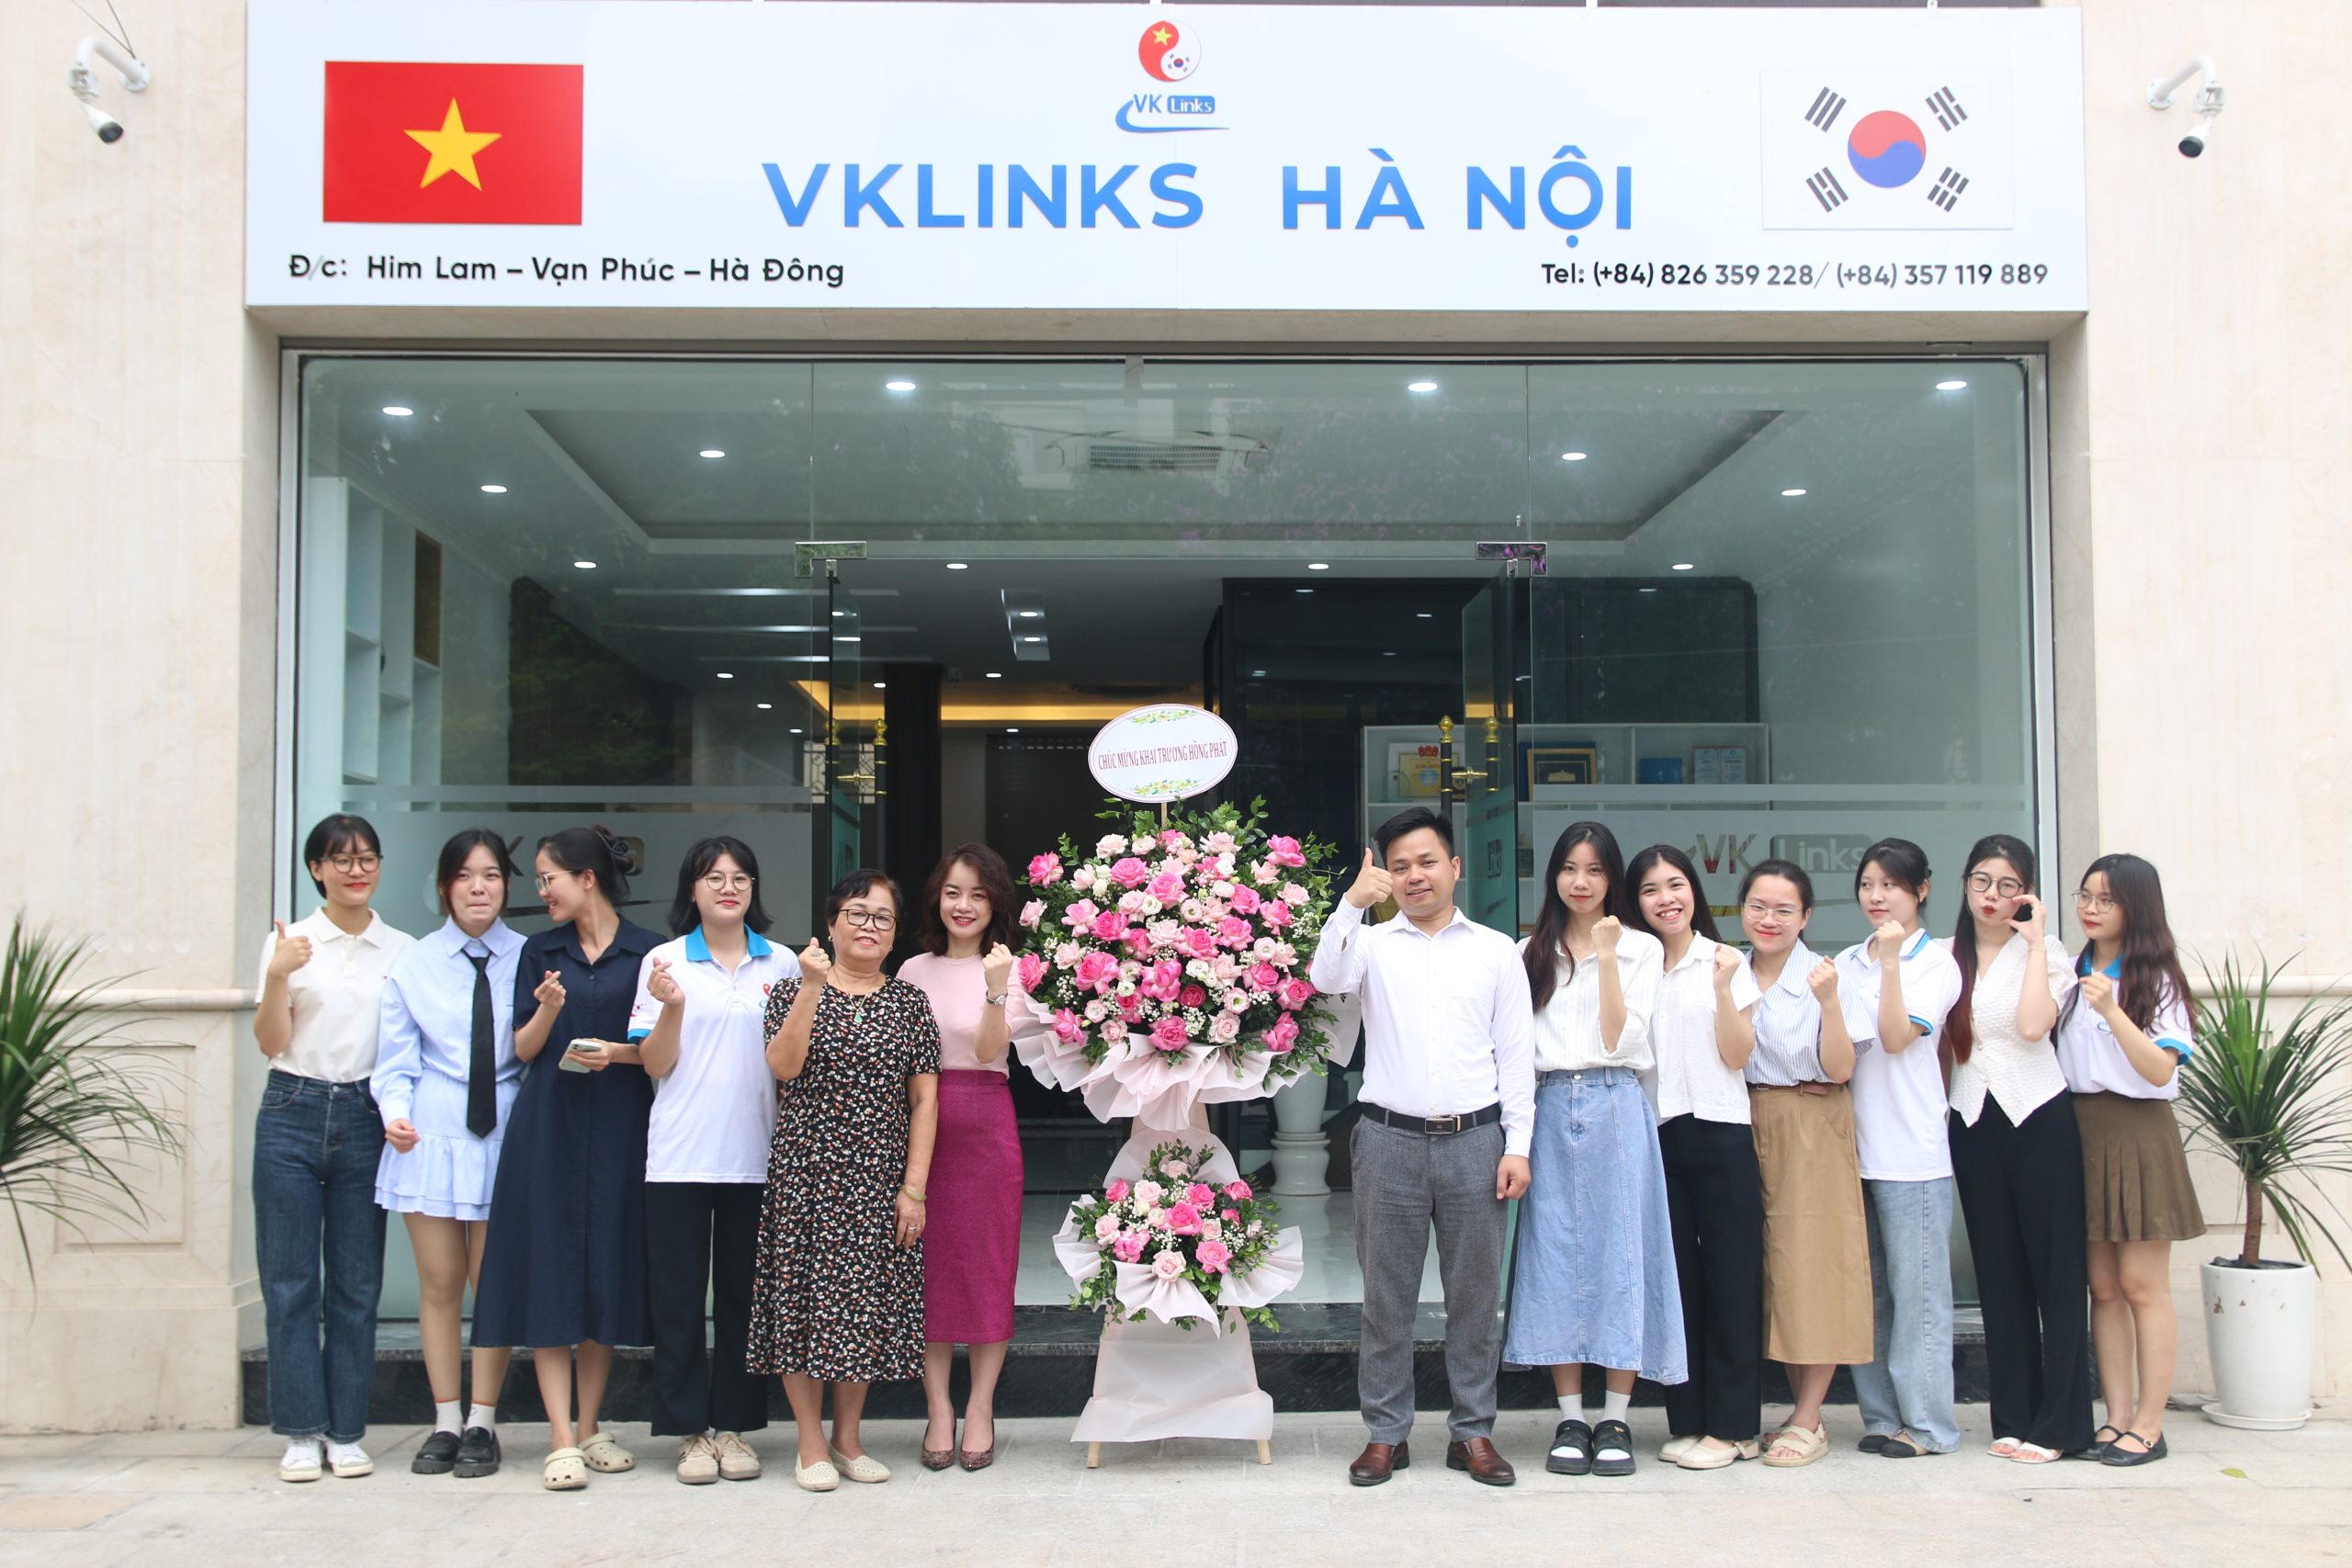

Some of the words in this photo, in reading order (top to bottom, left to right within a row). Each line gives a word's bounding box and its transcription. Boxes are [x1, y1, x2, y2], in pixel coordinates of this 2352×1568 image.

[1133, 93, 1163, 114] VK
[1170, 96, 1213, 113] Links
[761, 162, 1204, 230] VKLINKS
[1282, 147, 1426, 231] HÀ
[1466, 144, 1632, 249] NỘI
[288, 254, 347, 280] Đ/c:
[367, 254, 423, 280] Him
[435, 255, 497, 281] Lam
[530, 255, 588, 288] Vạn
[601, 255, 675, 282] Phúc
[709, 255, 750, 282] Hà
[762, 255, 845, 290] Đông
[1541, 262, 1585, 285] Tel:
[1593, 261, 1655, 288] (+84)
[1660, 263, 1708, 286] 826
[1714, 263, 1760, 286] 359
[1837, 261, 1898, 289] (+84)
[1905, 263, 1948, 286] 357
[1954, 263, 1993, 286] 119
[2000, 263, 2049, 286] 889
[1098, 750, 1116, 770] CHÚC
[1117, 747, 1139, 768] MỪNG
[1139, 749, 1158, 766] KHAI
[1189, 739, 1209, 761] HỒNG
[1209, 738, 1227, 758] PHÁT
[1695, 833, 1758, 874] VK
